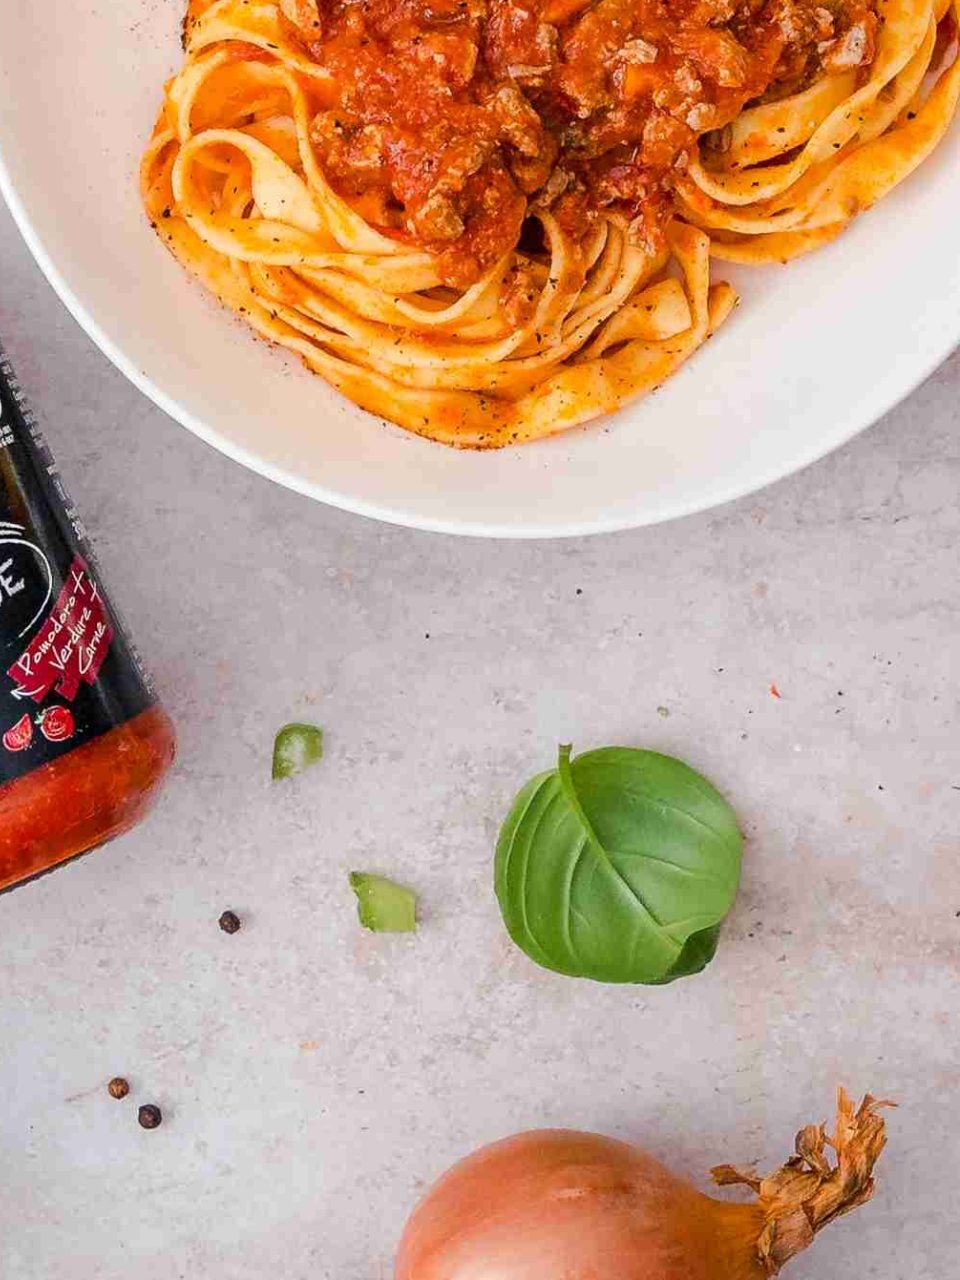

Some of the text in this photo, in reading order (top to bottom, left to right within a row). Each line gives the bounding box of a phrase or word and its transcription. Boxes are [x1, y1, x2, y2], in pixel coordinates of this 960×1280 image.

[17, 595, 76, 676] Pomodoro
[48, 606, 92, 670] Verdure
[78, 621, 107, 675] Carne
